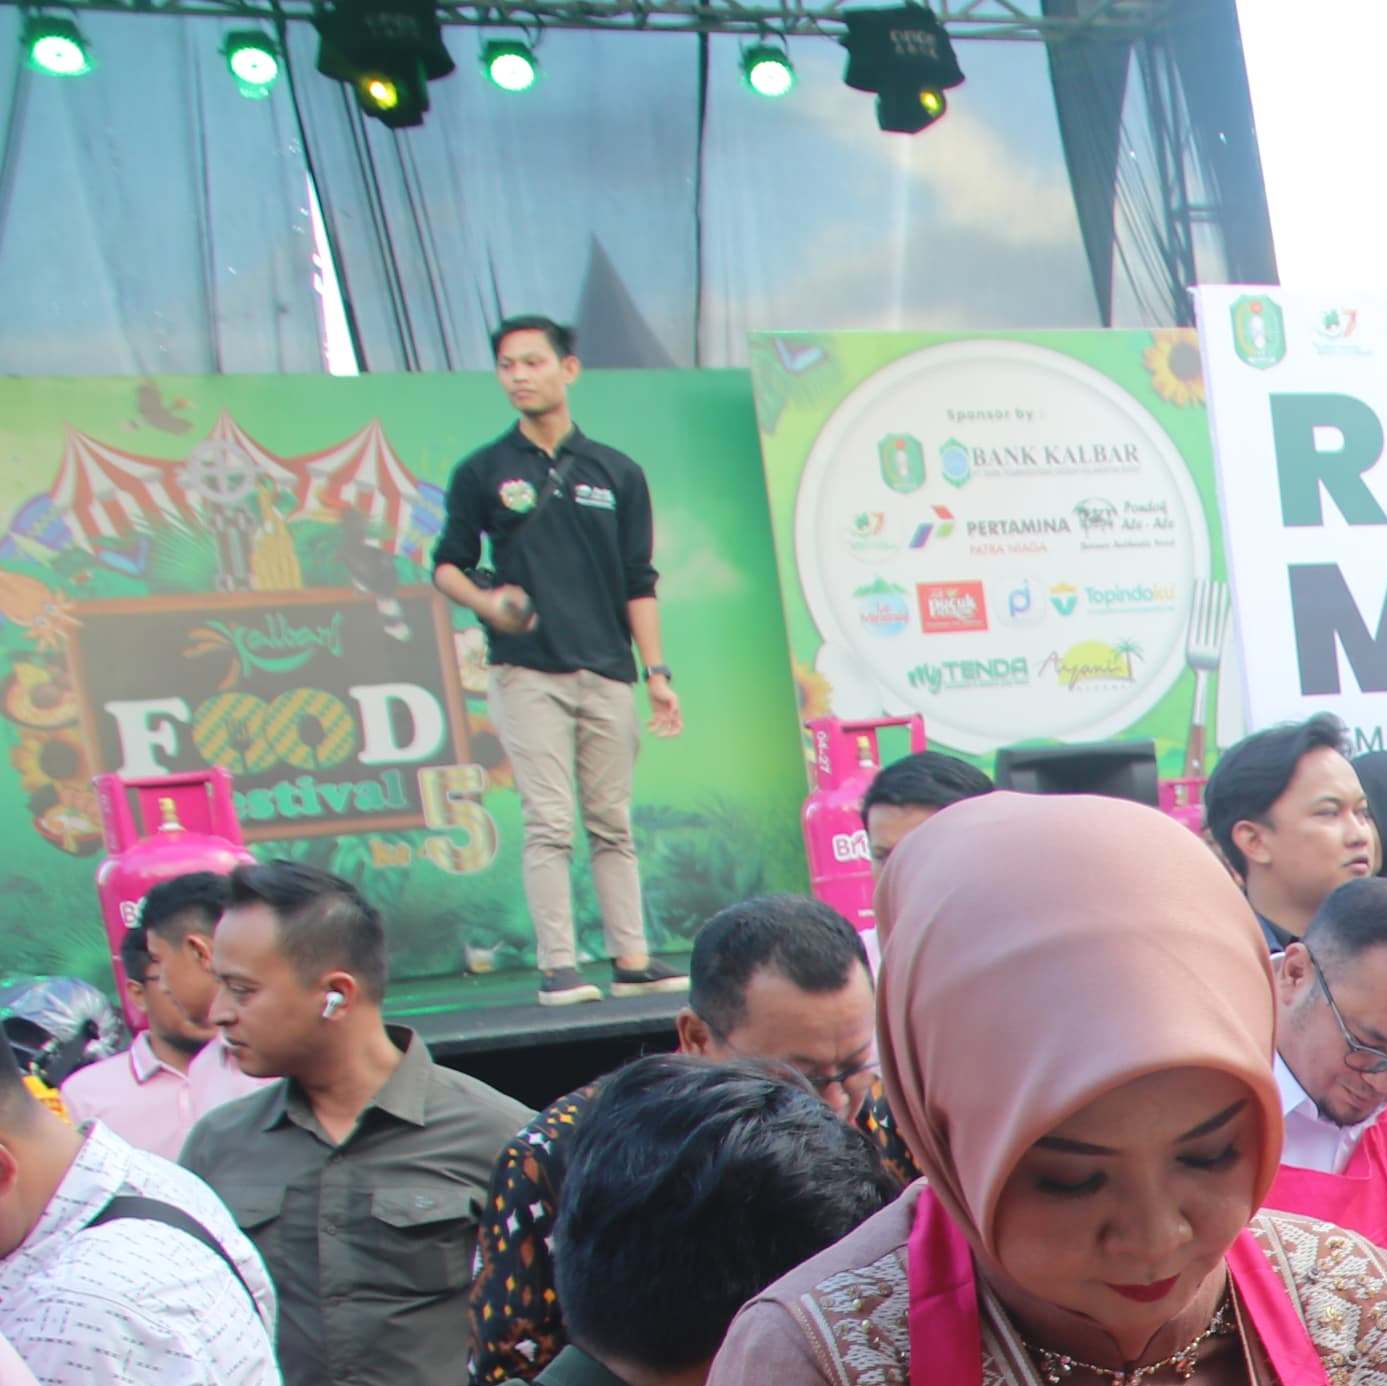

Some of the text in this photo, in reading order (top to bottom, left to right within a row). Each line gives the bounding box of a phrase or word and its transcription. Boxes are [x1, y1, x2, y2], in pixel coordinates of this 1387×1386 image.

[947, 408, 1009, 424] Sponsor
[1016, 409, 1033, 421] by
[973, 445, 1139, 466] BANK KALBAR
[967, 518, 1071, 536] PERTAMINA
[942, 656, 1029, 681] TENDA
[104, 684, 445, 779] FOOD
[234, 772, 407, 821] estival
[418, 764, 497, 874] 5
